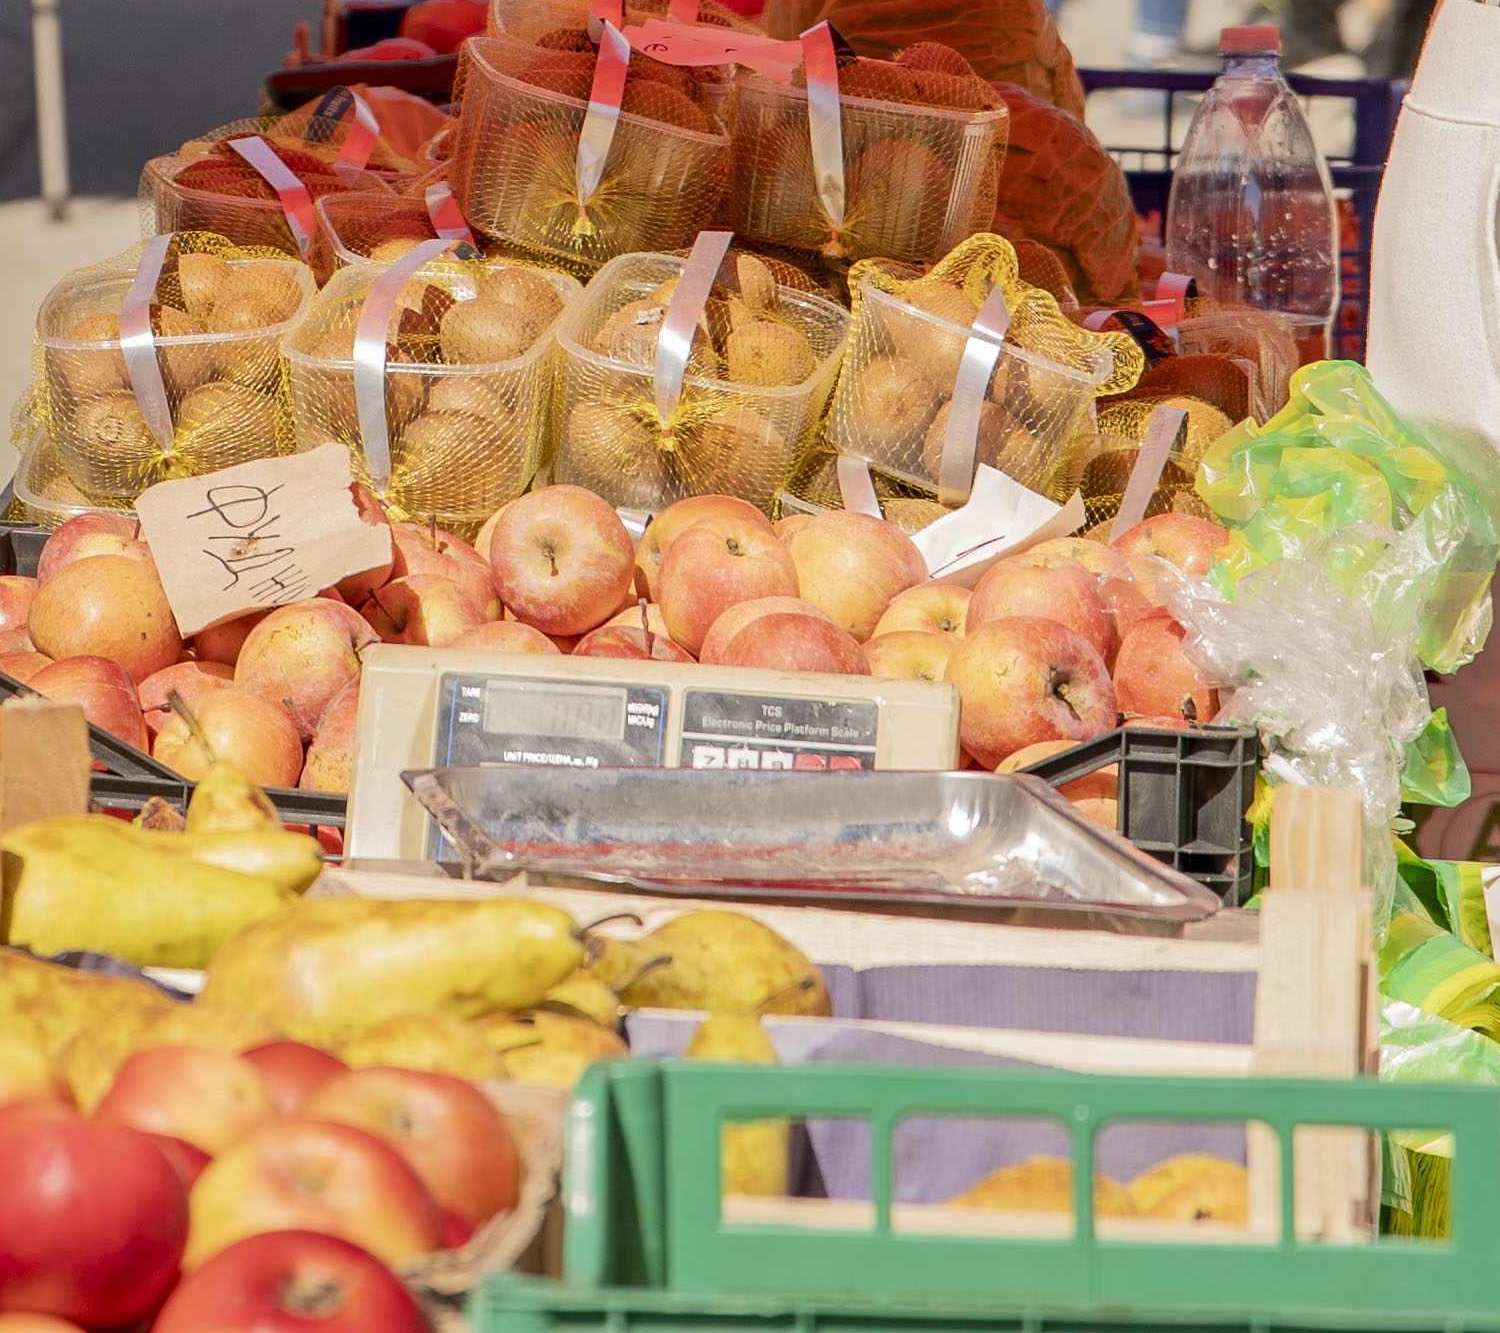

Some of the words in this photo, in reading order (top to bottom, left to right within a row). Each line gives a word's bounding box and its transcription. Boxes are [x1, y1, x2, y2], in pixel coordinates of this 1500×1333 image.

[457, 711, 480, 724] ZERO
[761, 704, 784, 718] TCS
[701, 716, 753, 732] Electronic
[755, 720, 782, 734] Price
[783, 722, 830, 737] Platform
[830, 726, 860, 739] Scale
